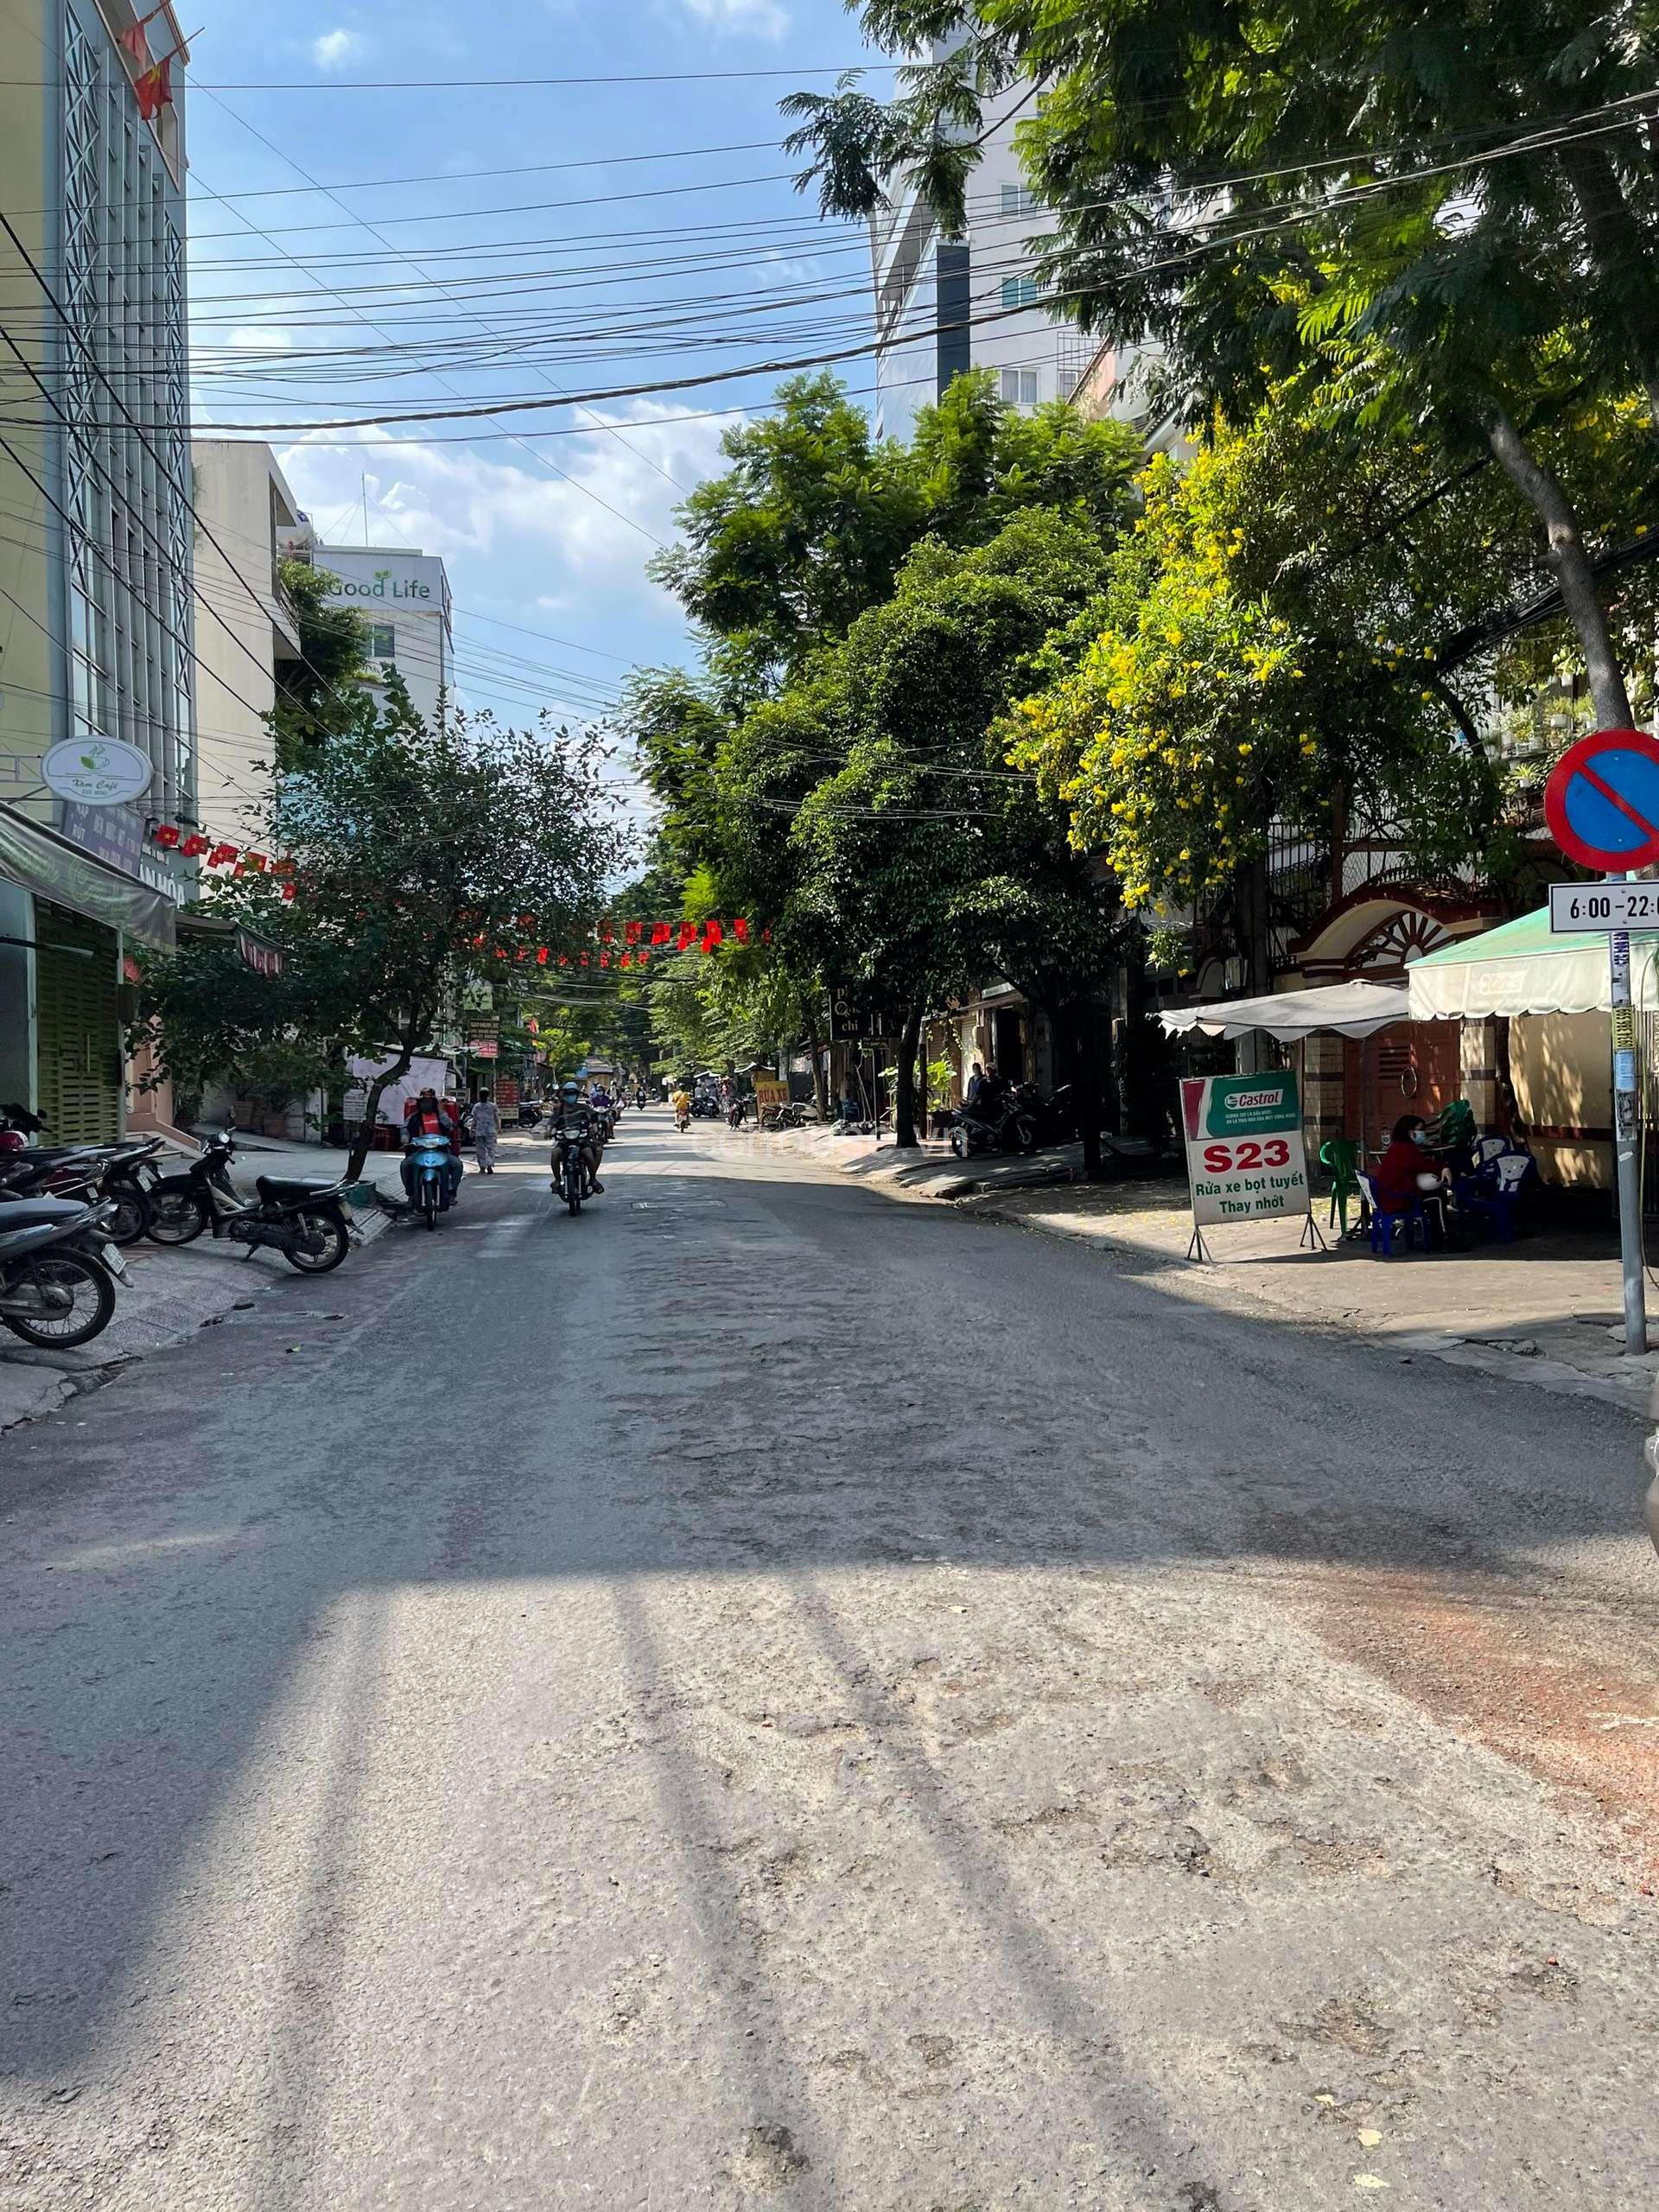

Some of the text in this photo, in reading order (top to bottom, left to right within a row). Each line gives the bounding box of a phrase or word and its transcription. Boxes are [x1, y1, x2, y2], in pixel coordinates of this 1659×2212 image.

[393, 580, 430, 598] Life
[1239, 1091, 1279, 1107] Castrol
[1203, 1139, 1291, 1173] S23
[1195, 1171, 1304, 1197] Rửa xe bọt tuyết
[1219, 1195, 1285, 1213] Thay nhớt
